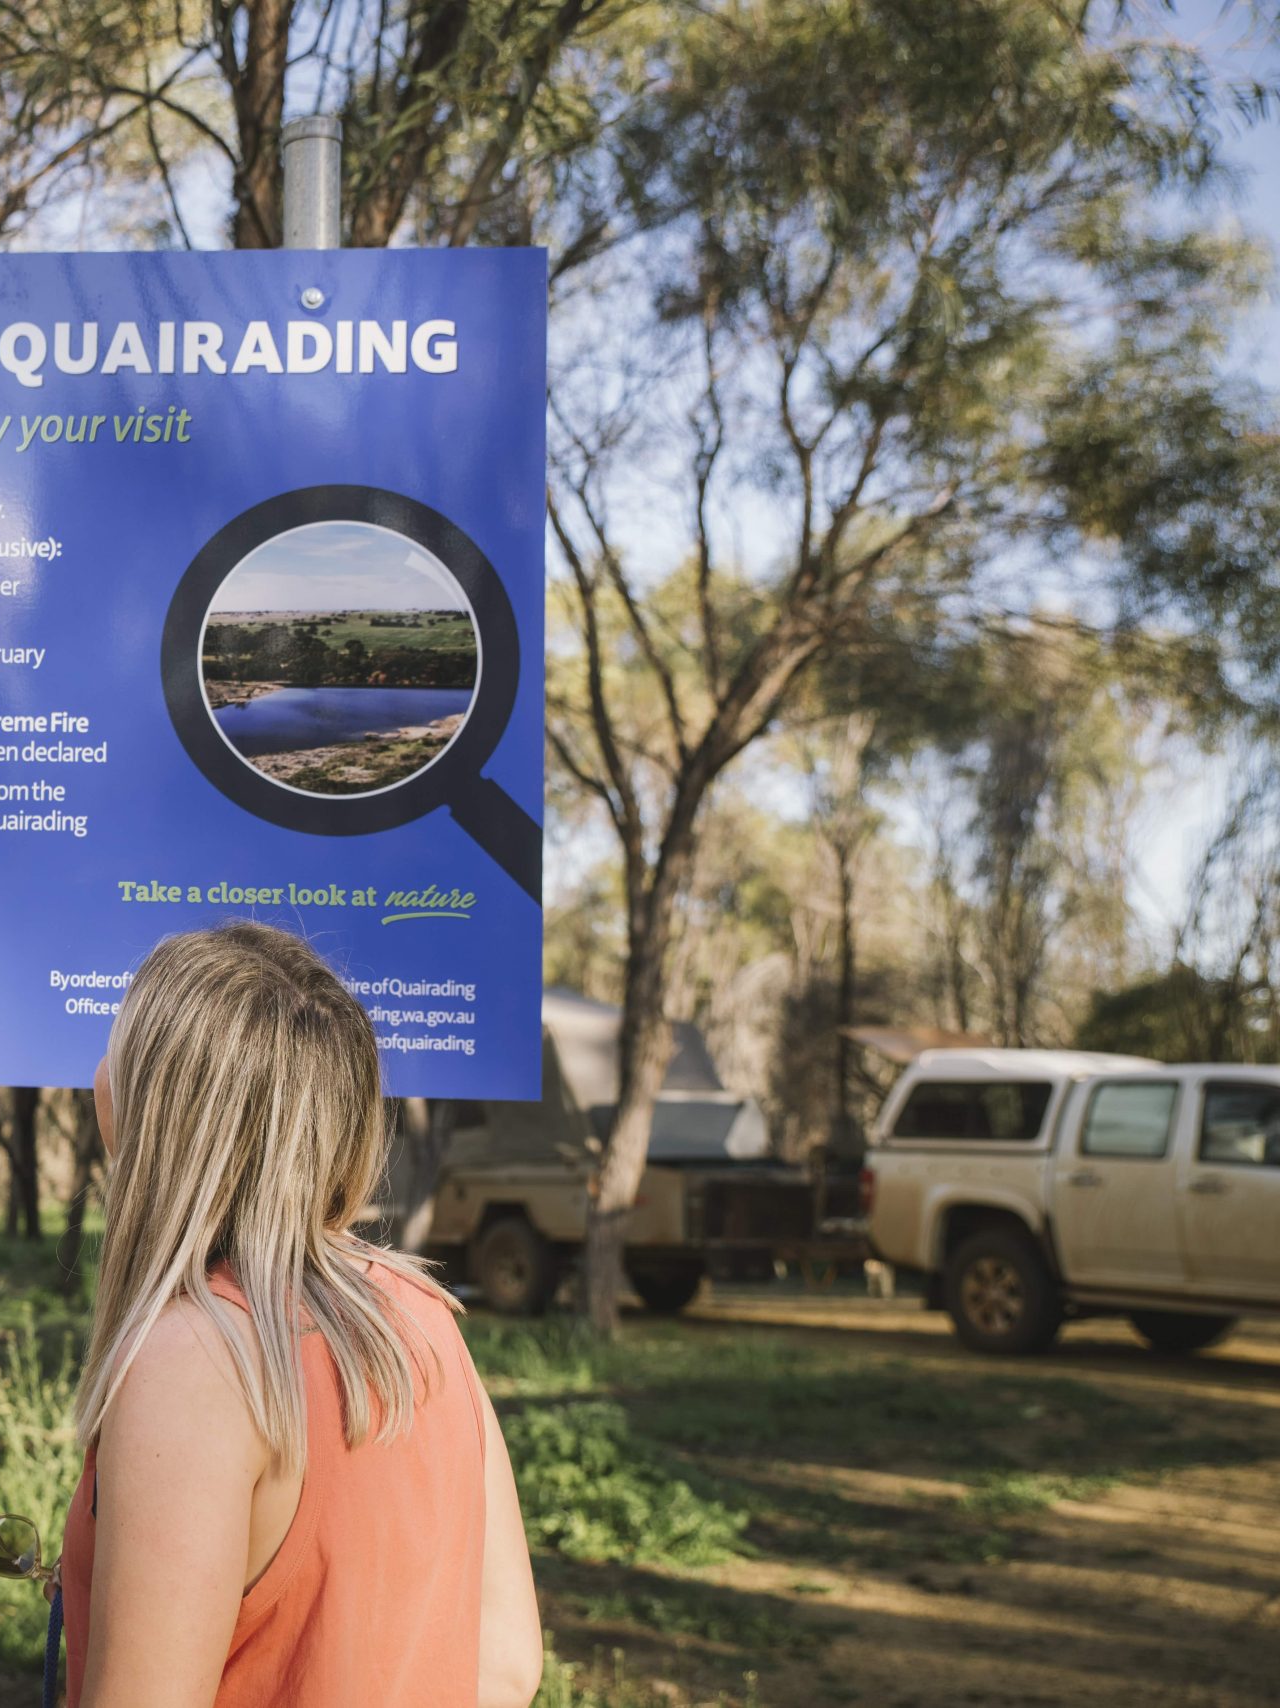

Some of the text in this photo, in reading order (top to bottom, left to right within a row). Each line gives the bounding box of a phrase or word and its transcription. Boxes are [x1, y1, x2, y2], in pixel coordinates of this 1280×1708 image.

[15, 415, 106, 453] your
[113, 406, 192, 443] visit
[51, 712, 88, 732] Fire
[22, 741, 106, 762] declared
[32, 780, 65, 801] the
[118, 880, 477, 910] Take a closer look at nature
[50, 969, 70, 992] By
[70, 969, 112, 989] order
[371, 978, 389, 996] of
[388, 978, 477, 1001] Quairading
[65, 997, 110, 1016] Office
[369, 1006, 475, 1028] ding.wa.gov.au
